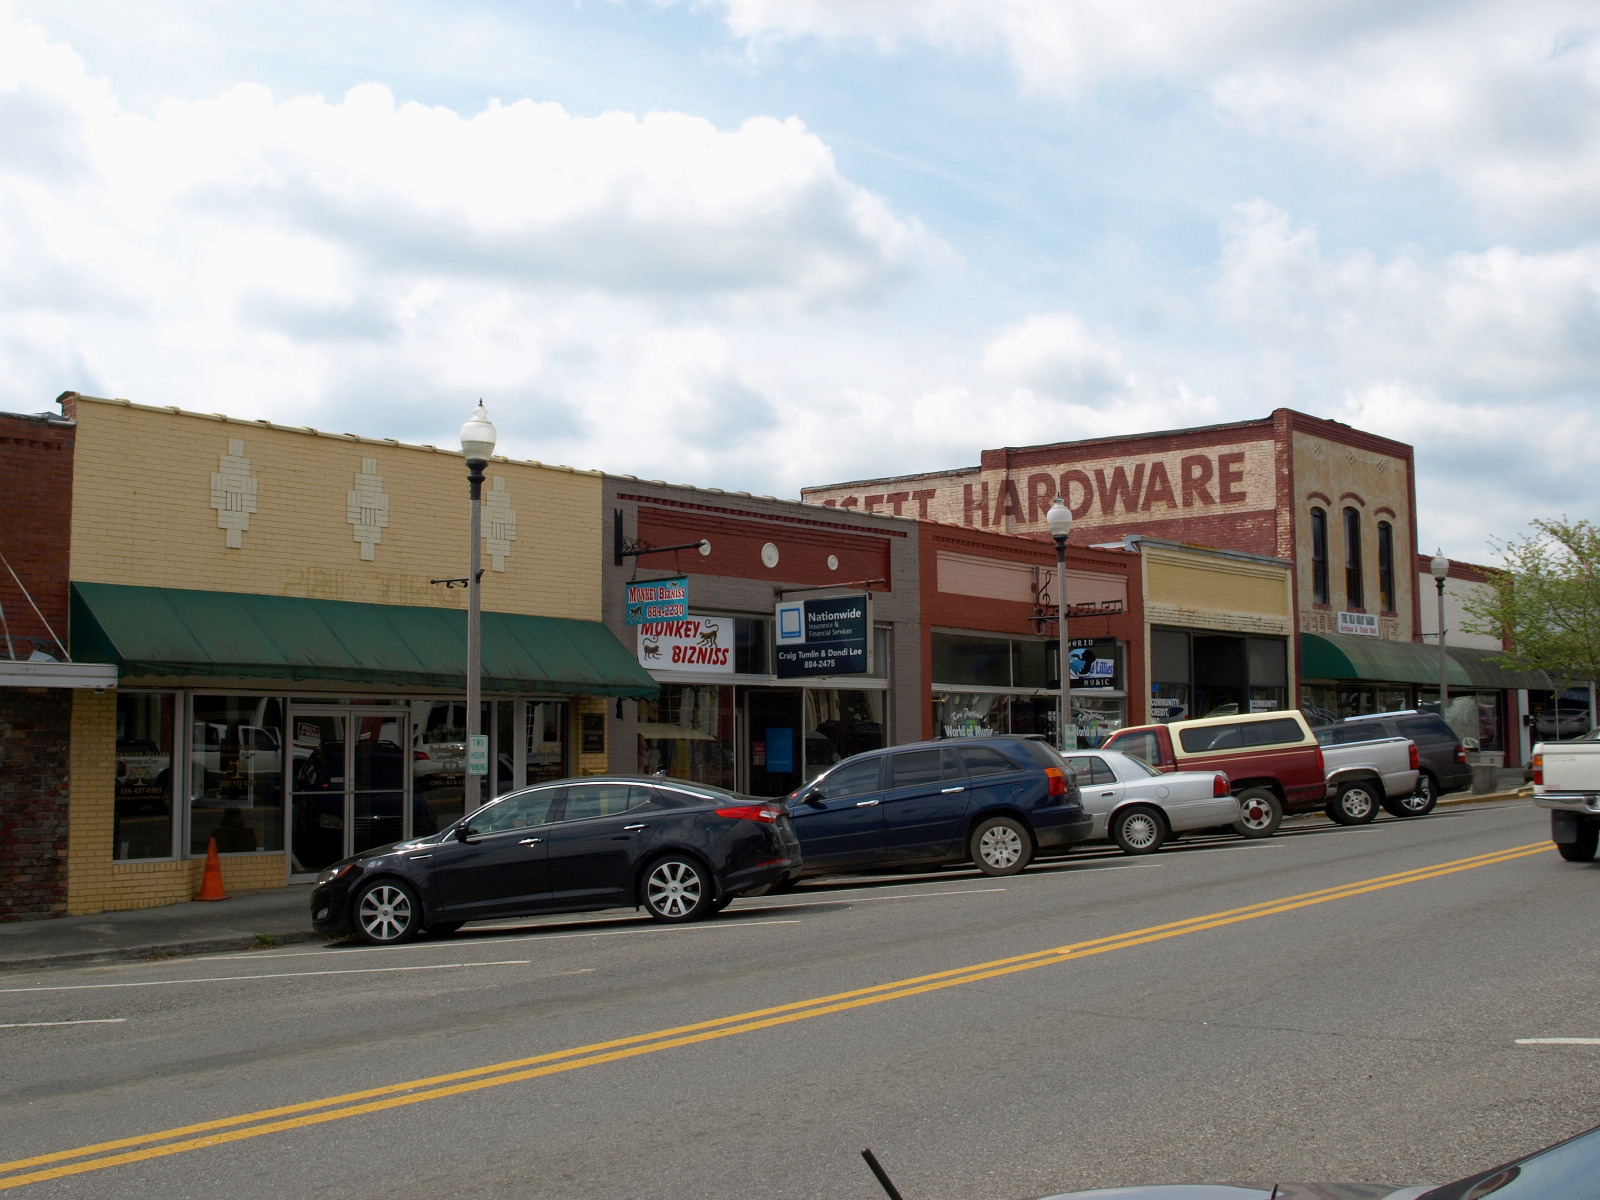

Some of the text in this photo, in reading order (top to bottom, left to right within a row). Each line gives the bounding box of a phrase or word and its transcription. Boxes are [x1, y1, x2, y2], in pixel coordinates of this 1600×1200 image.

[963, 451, 1247, 527] HARDWARE
[629, 586, 685, 602] MONKEY BIZNISS
[647, 604, 684, 617] 884-2230
[808, 608, 862, 622] Nationwide
[640, 620, 701, 639] MONKEY
[809, 629, 831, 638] Financial
[832, 628, 852, 636] Services
[671, 645, 729, 666] BIZNISS
[779, 652, 797, 661] Craig
[798, 650, 819, 659] Tumlin
[828, 648, 848, 657] Dondi
[804, 659, 836, 669] 884-2475
[1083, 679, 1110, 687] MUSIC
[945, 725, 965, 738] World
[471, 751, 486, 759] HOUR
[469, 764, 487, 772] PARKING
